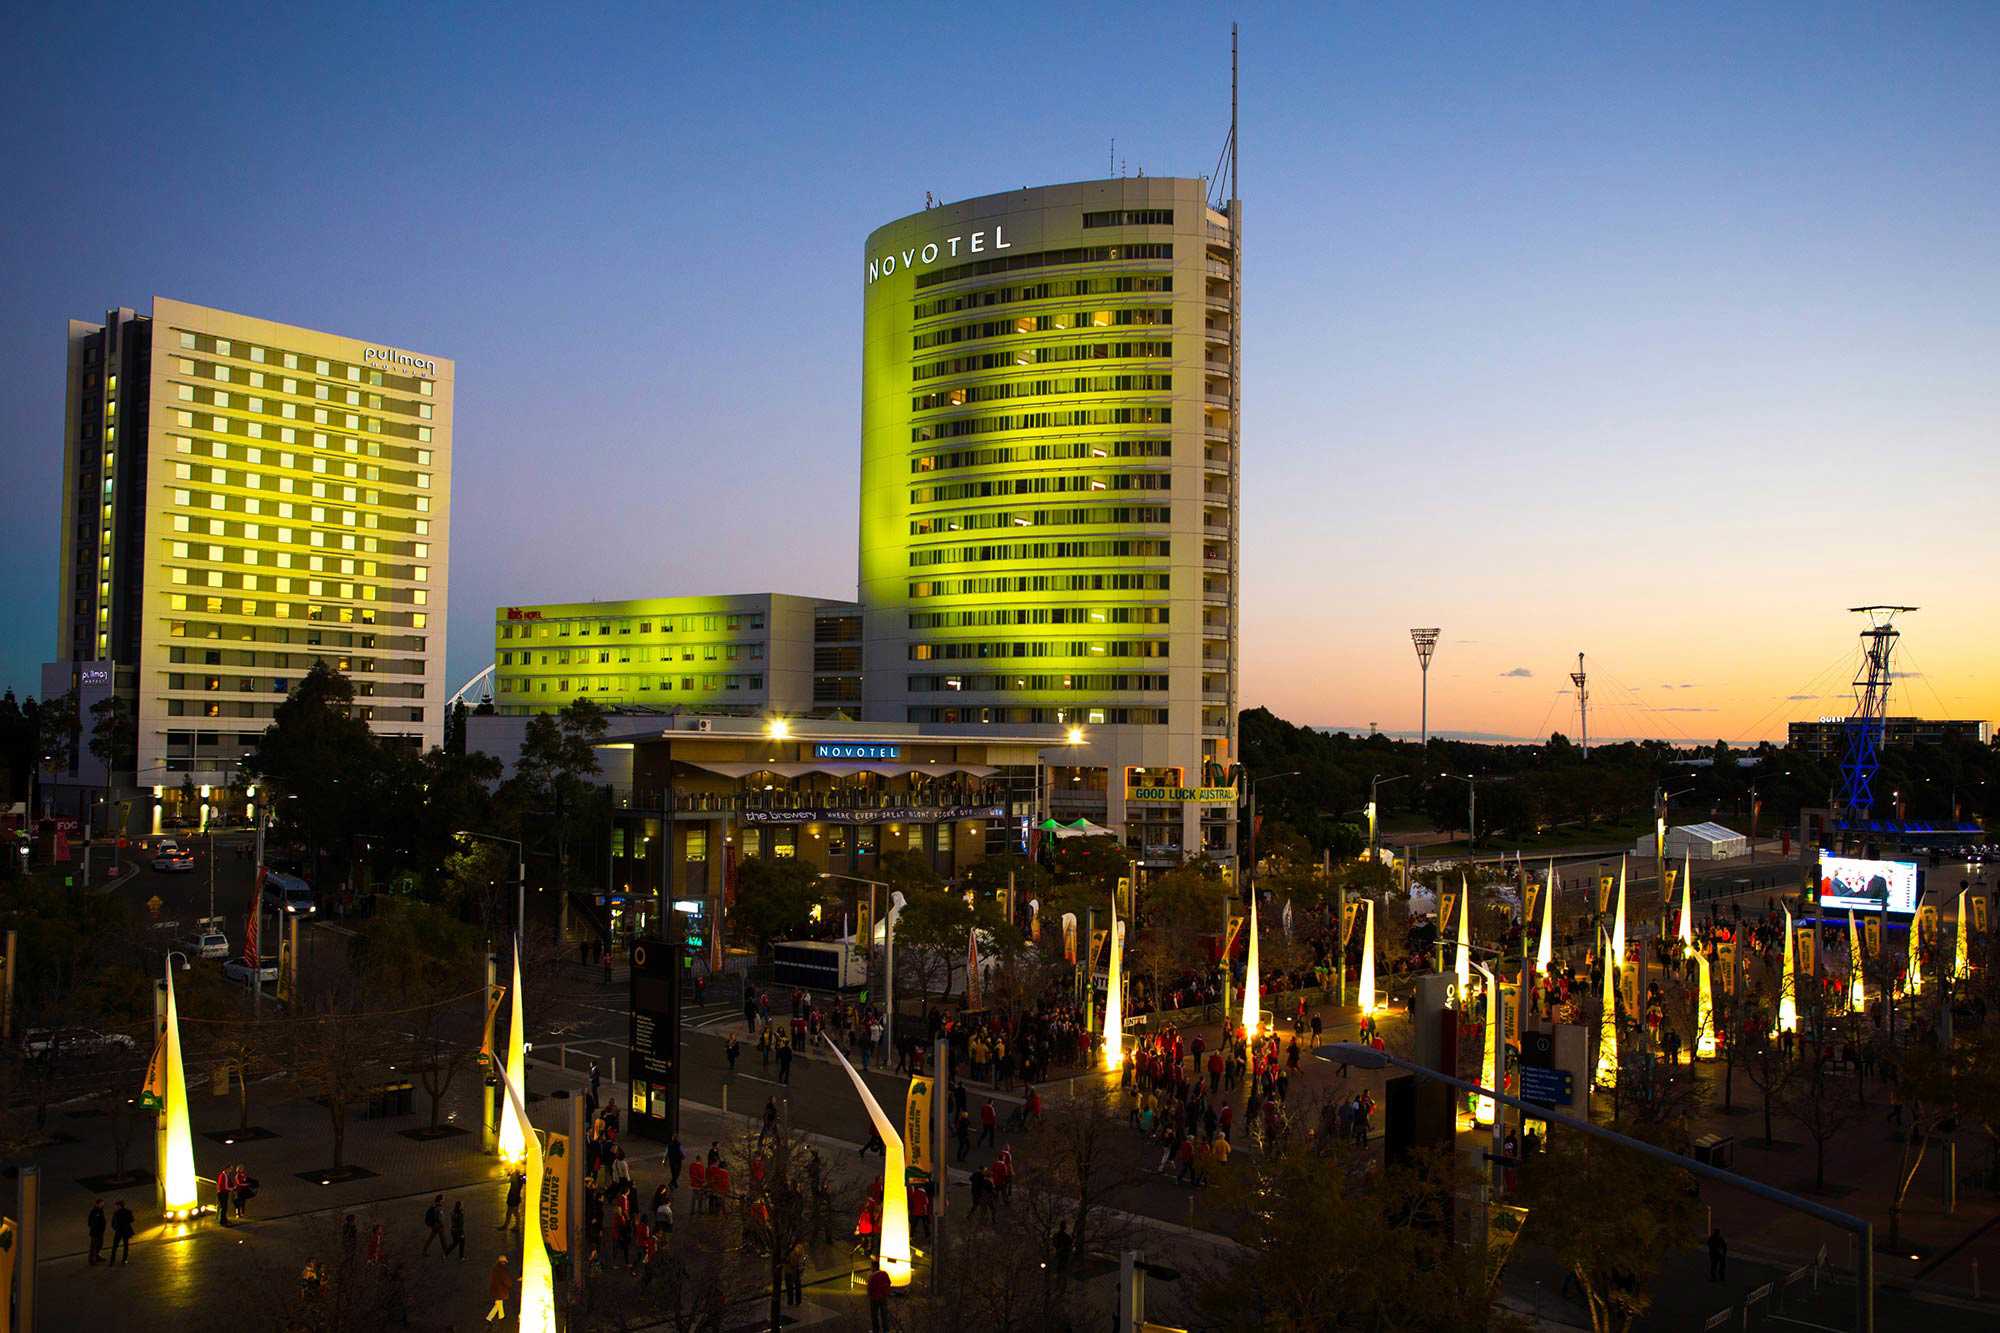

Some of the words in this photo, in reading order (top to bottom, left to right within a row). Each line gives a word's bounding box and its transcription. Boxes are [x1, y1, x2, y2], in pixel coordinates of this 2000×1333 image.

[869, 225, 1012, 284] NOVOTEL
[364, 347, 436, 376] pullman
[1819, 715, 1846, 724] QUEST
[819, 745, 897, 758] NOVOTEL
[1136, 788, 1165, 799] GOOD
[1169, 788, 1197, 799] LUCK
[1199, 788, 1234, 799] AUSTRAL
[745, 811, 768, 821] the
[769, 811, 817, 821] brewery
